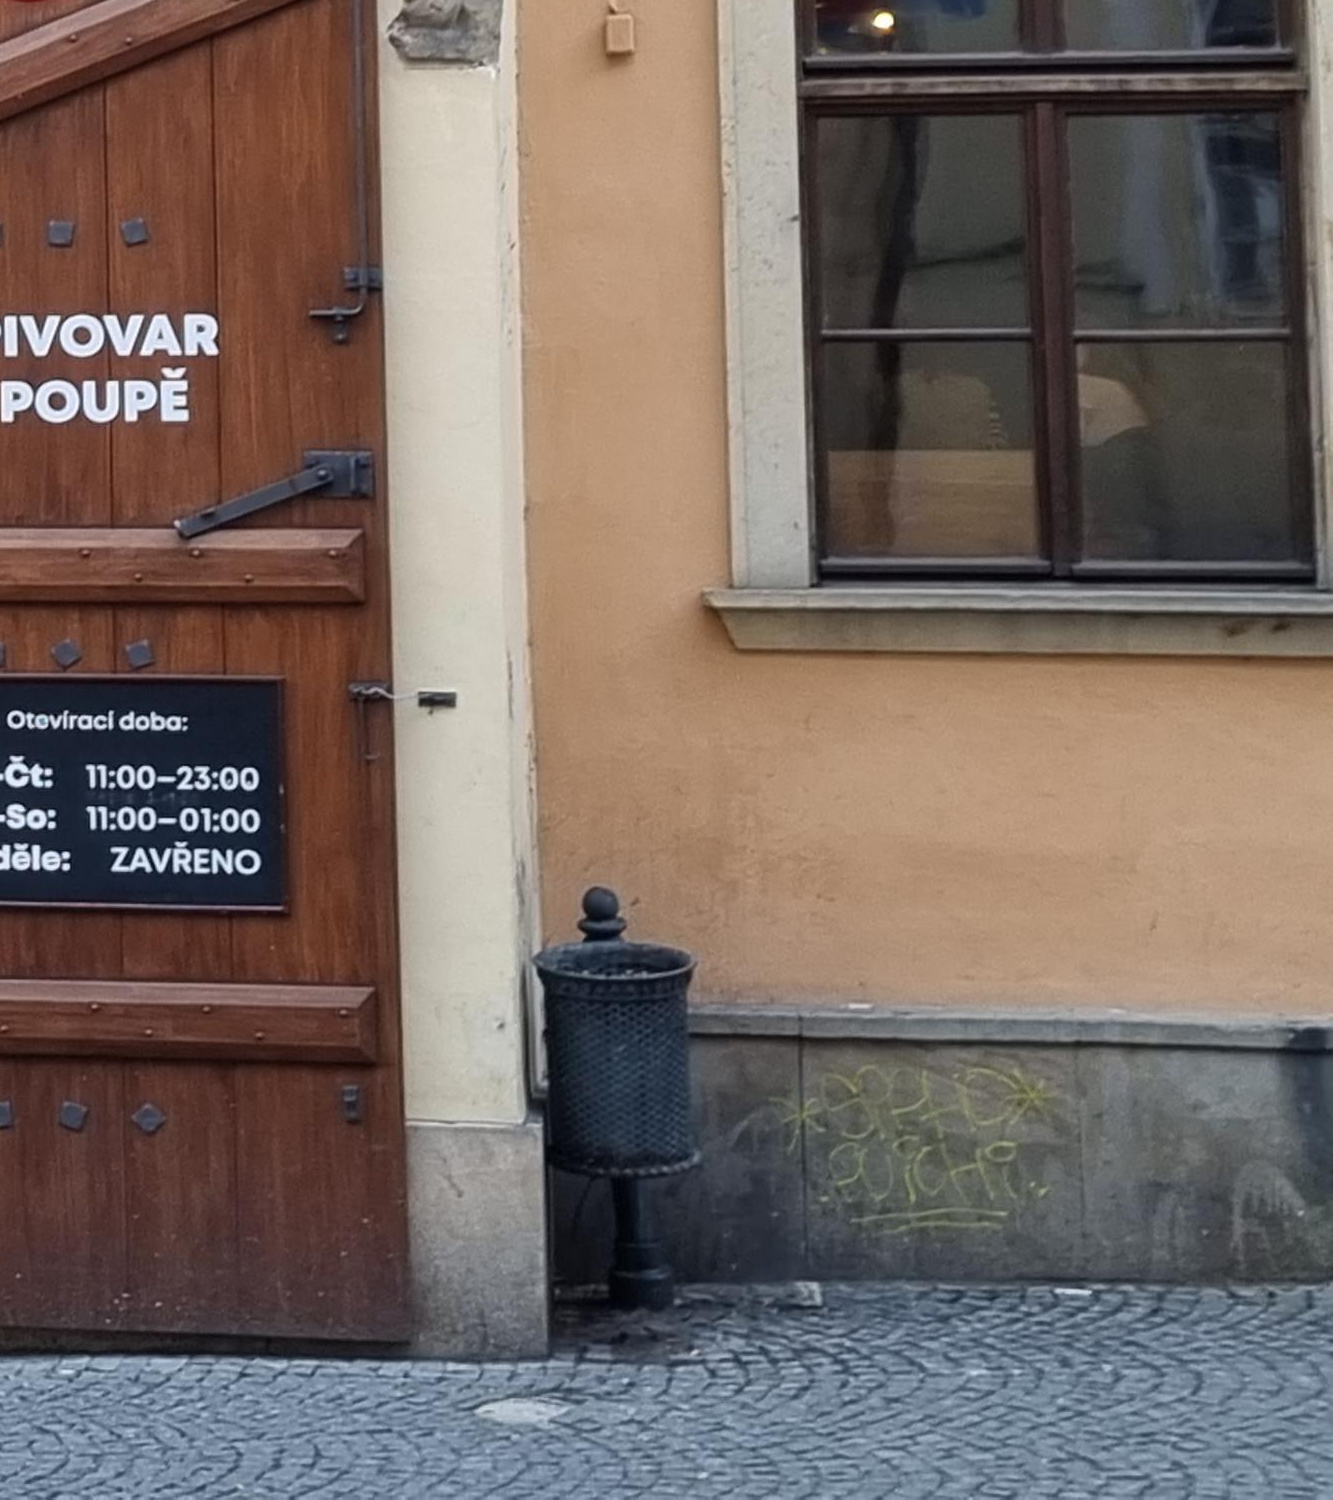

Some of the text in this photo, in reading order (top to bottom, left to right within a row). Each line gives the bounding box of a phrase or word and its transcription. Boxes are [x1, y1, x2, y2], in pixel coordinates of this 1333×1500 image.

[0, 367, 190, 424] POUPĚ
[6, 709, 188, 732] Otevírací doba:
[110, 840, 261, 875] ZAVŘENO
